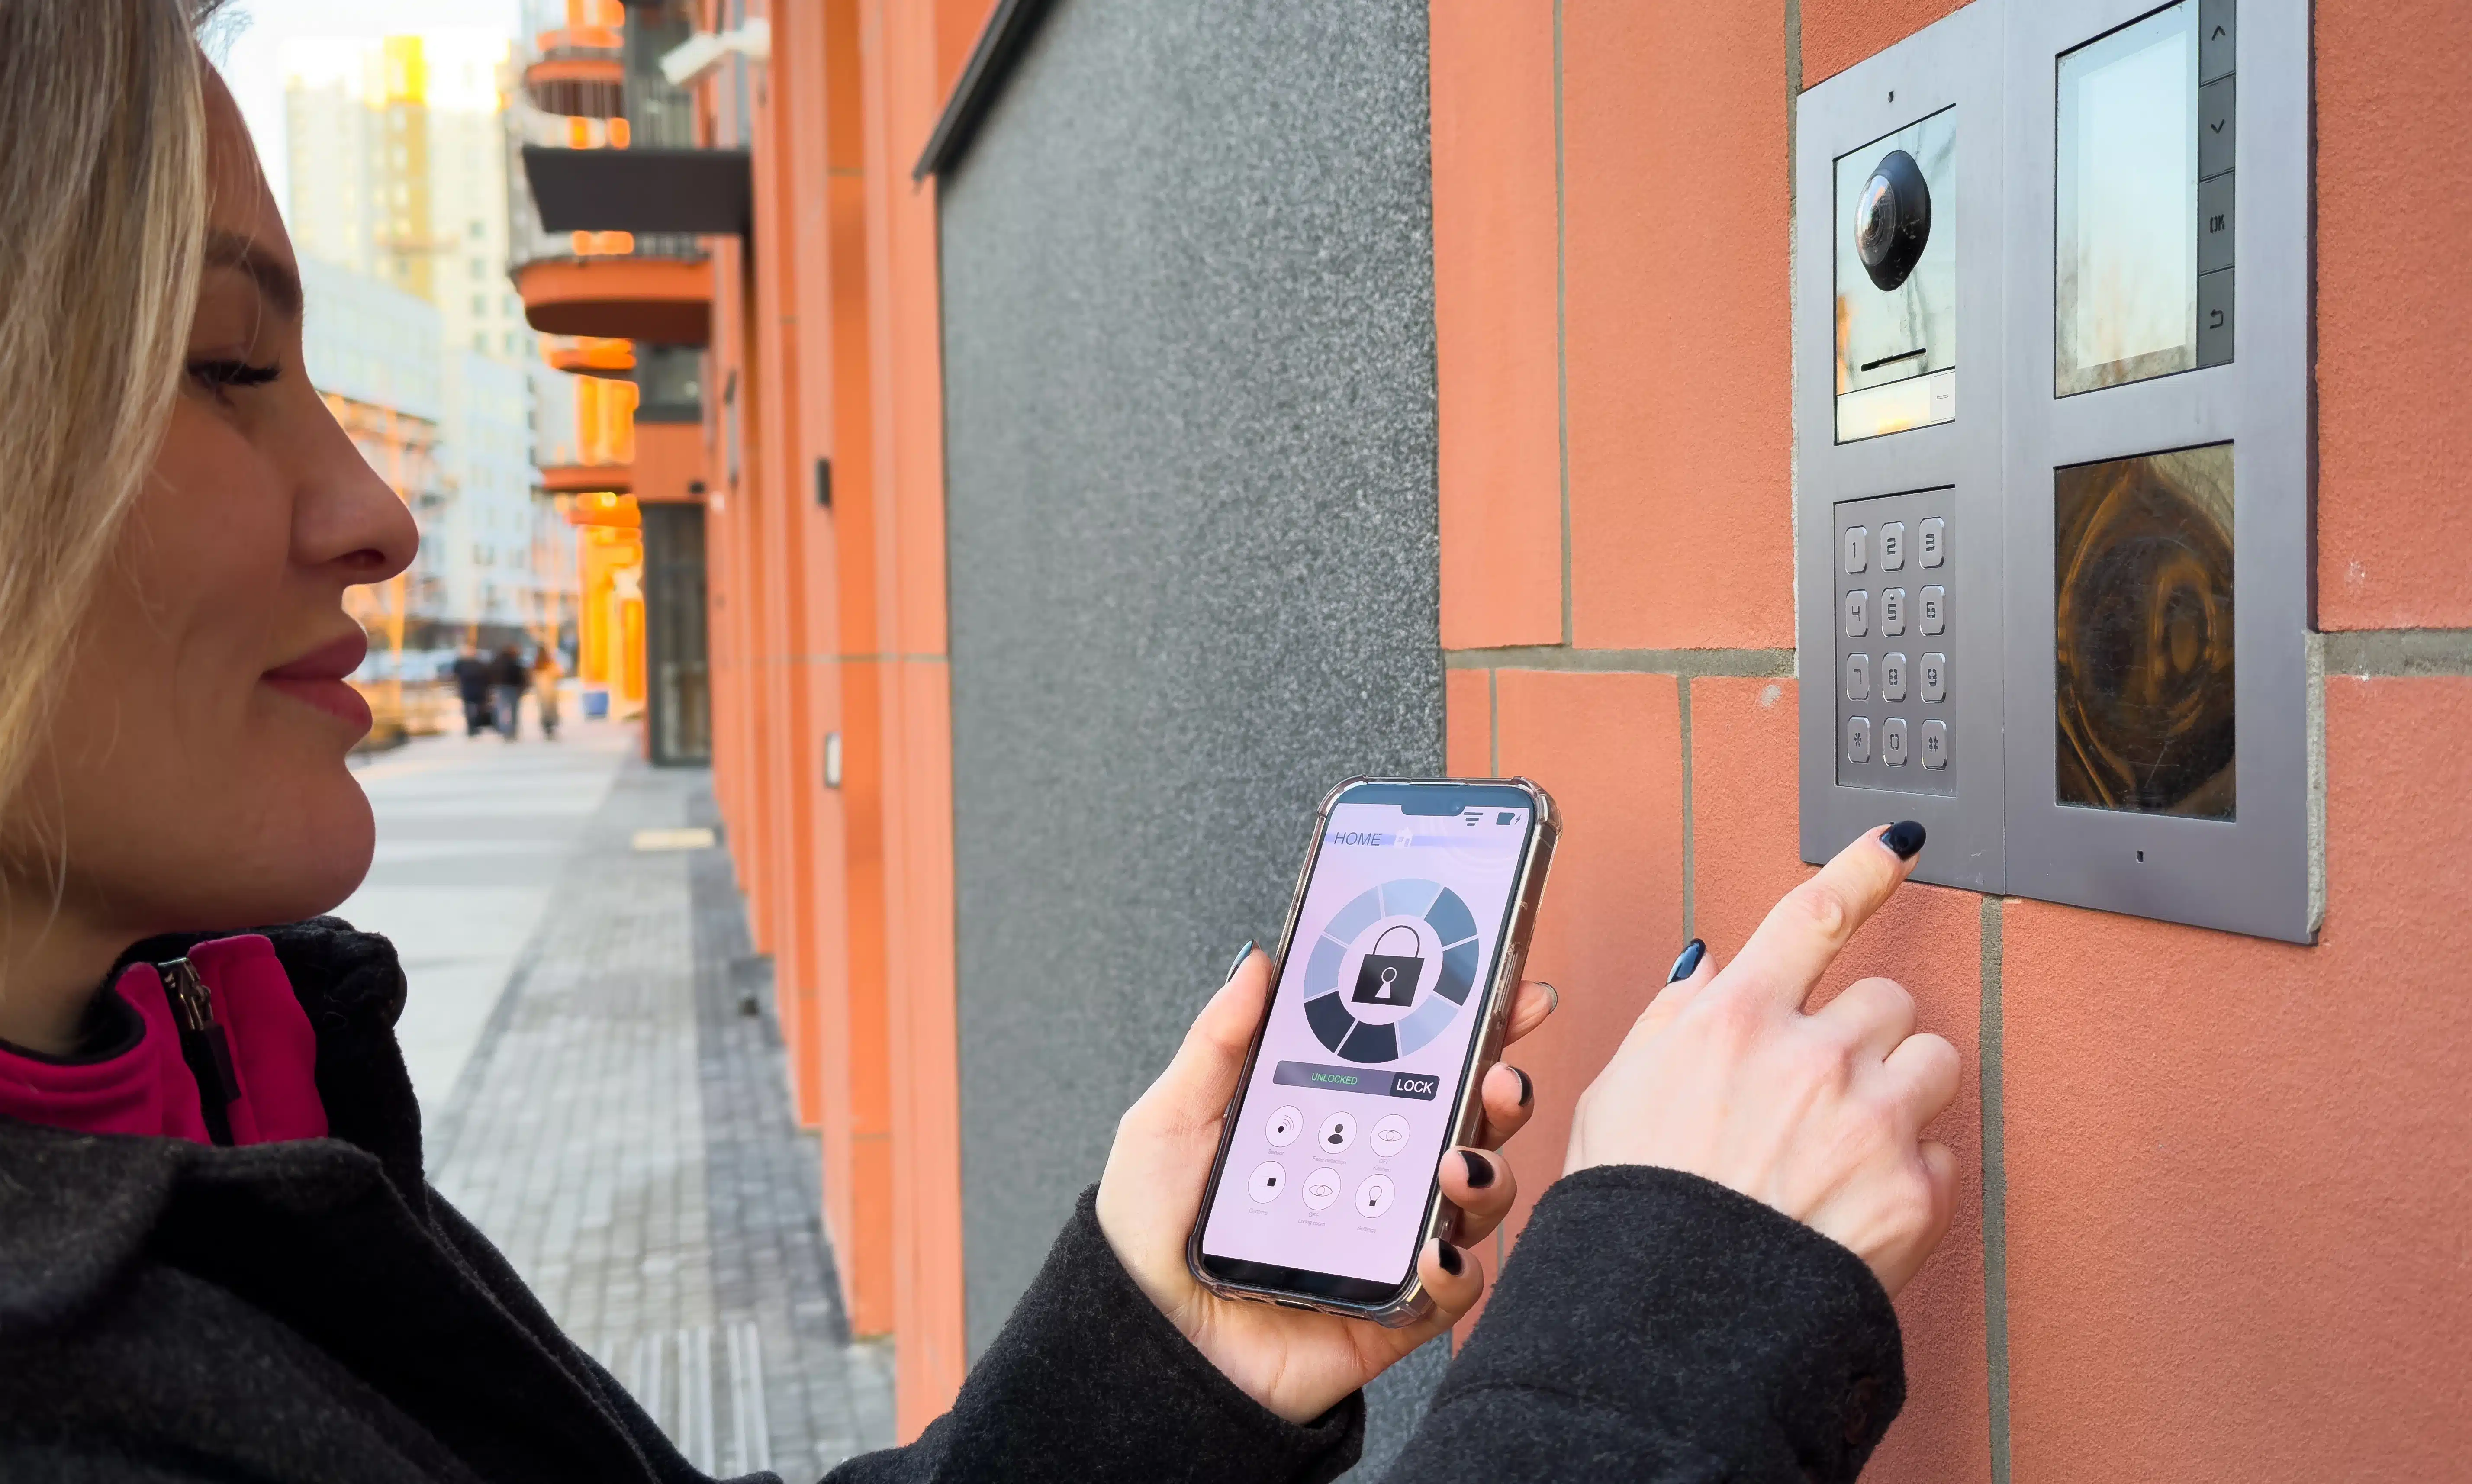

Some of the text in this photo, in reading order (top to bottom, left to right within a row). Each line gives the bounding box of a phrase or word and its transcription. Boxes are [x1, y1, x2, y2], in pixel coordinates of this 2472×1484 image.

[2210, 214, 2224, 233] OK
[1887, 538, 1896, 554] 2
[1925, 534, 1935, 551] 3
[1851, 602, 1936, 621] 4 5 6
[1853, 668, 1937, 686] 7 8 9
[1889, 733, 1899, 750] 0
[1334, 832, 1382, 846] HOME
[1311, 1072, 1358, 1085] UNLOCKED
[1396, 1079, 1434, 1094] LOCK
